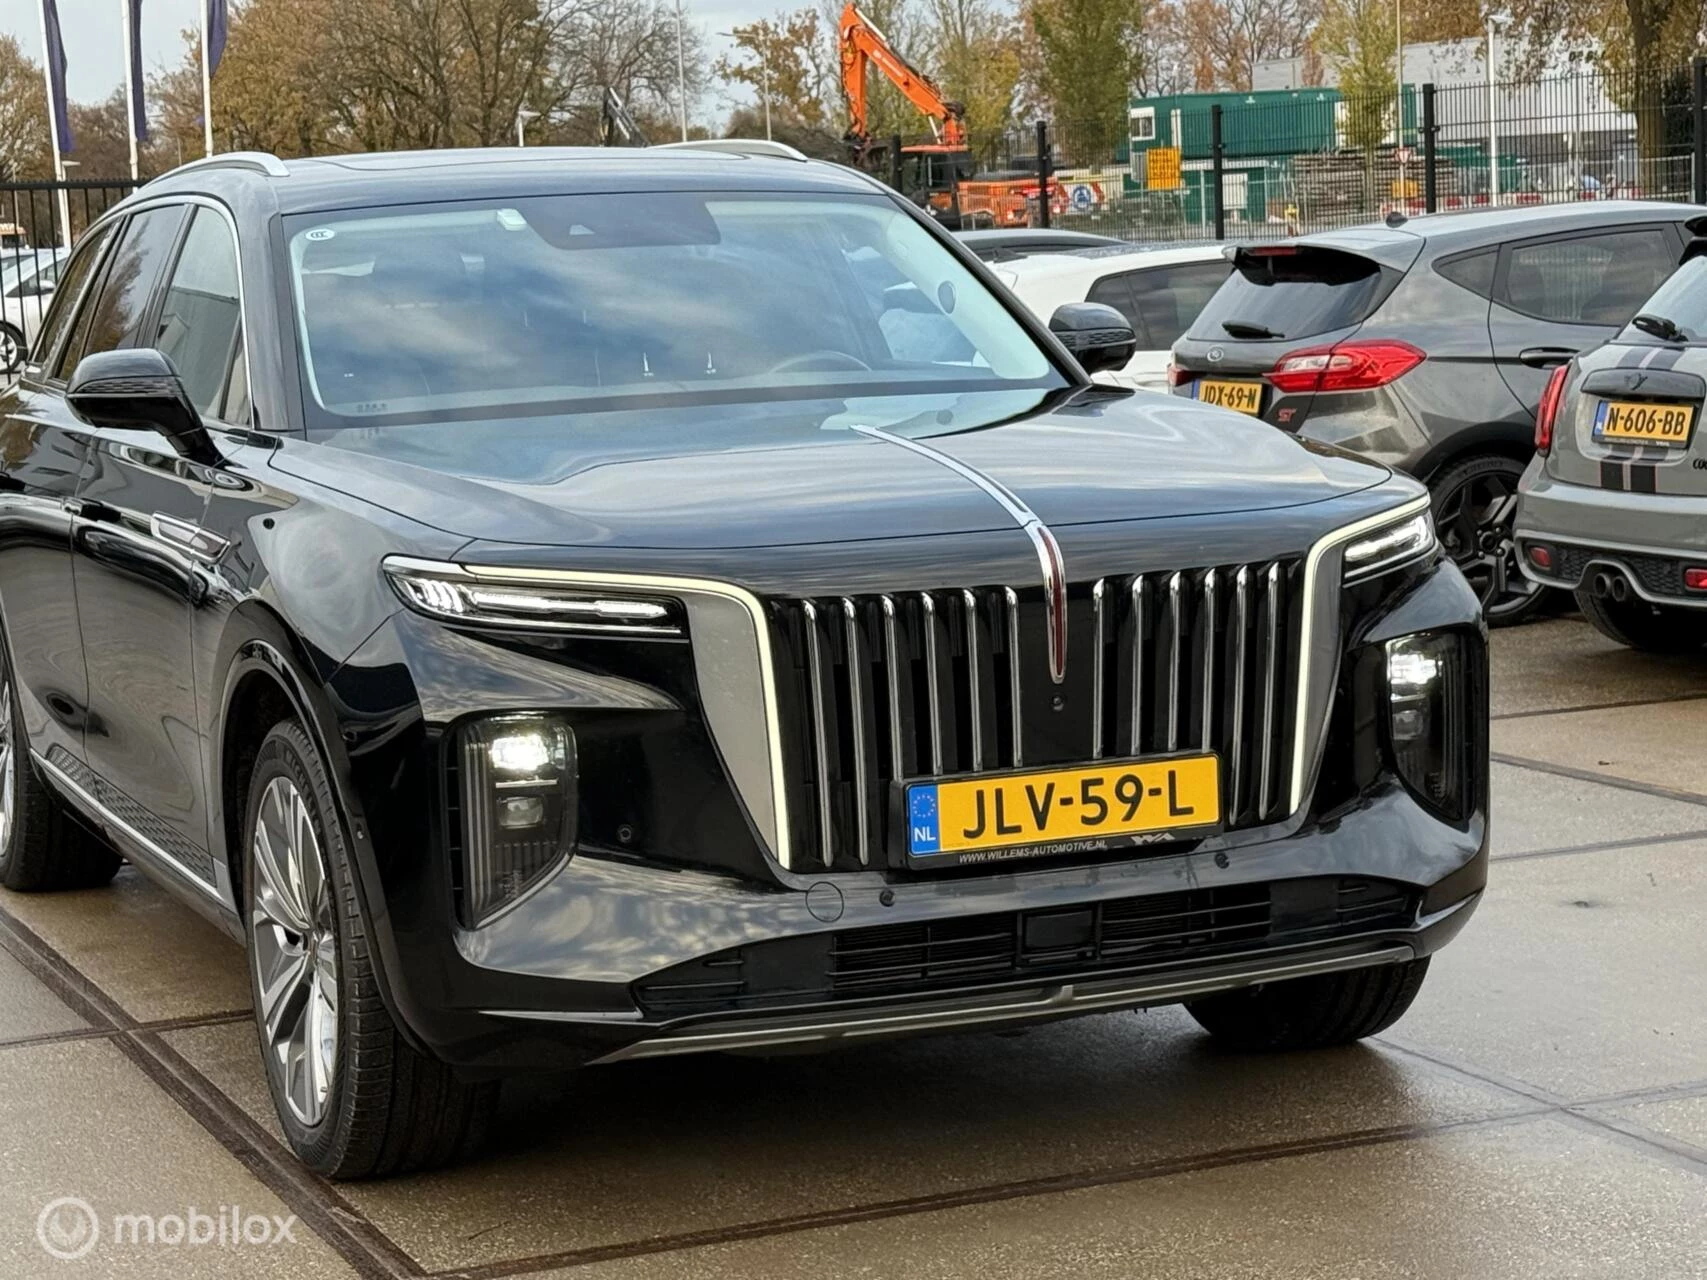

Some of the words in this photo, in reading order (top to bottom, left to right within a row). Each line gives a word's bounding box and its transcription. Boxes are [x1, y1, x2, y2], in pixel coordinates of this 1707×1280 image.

[1606, 407, 1686, 436] N-606-BB
[962, 769, 1195, 840] JLV-59-L
[913, 826, 936, 843] NL
[958, 839, 1108, 864] WWW.WILLEMS-AUTOMOTIVE.NL
